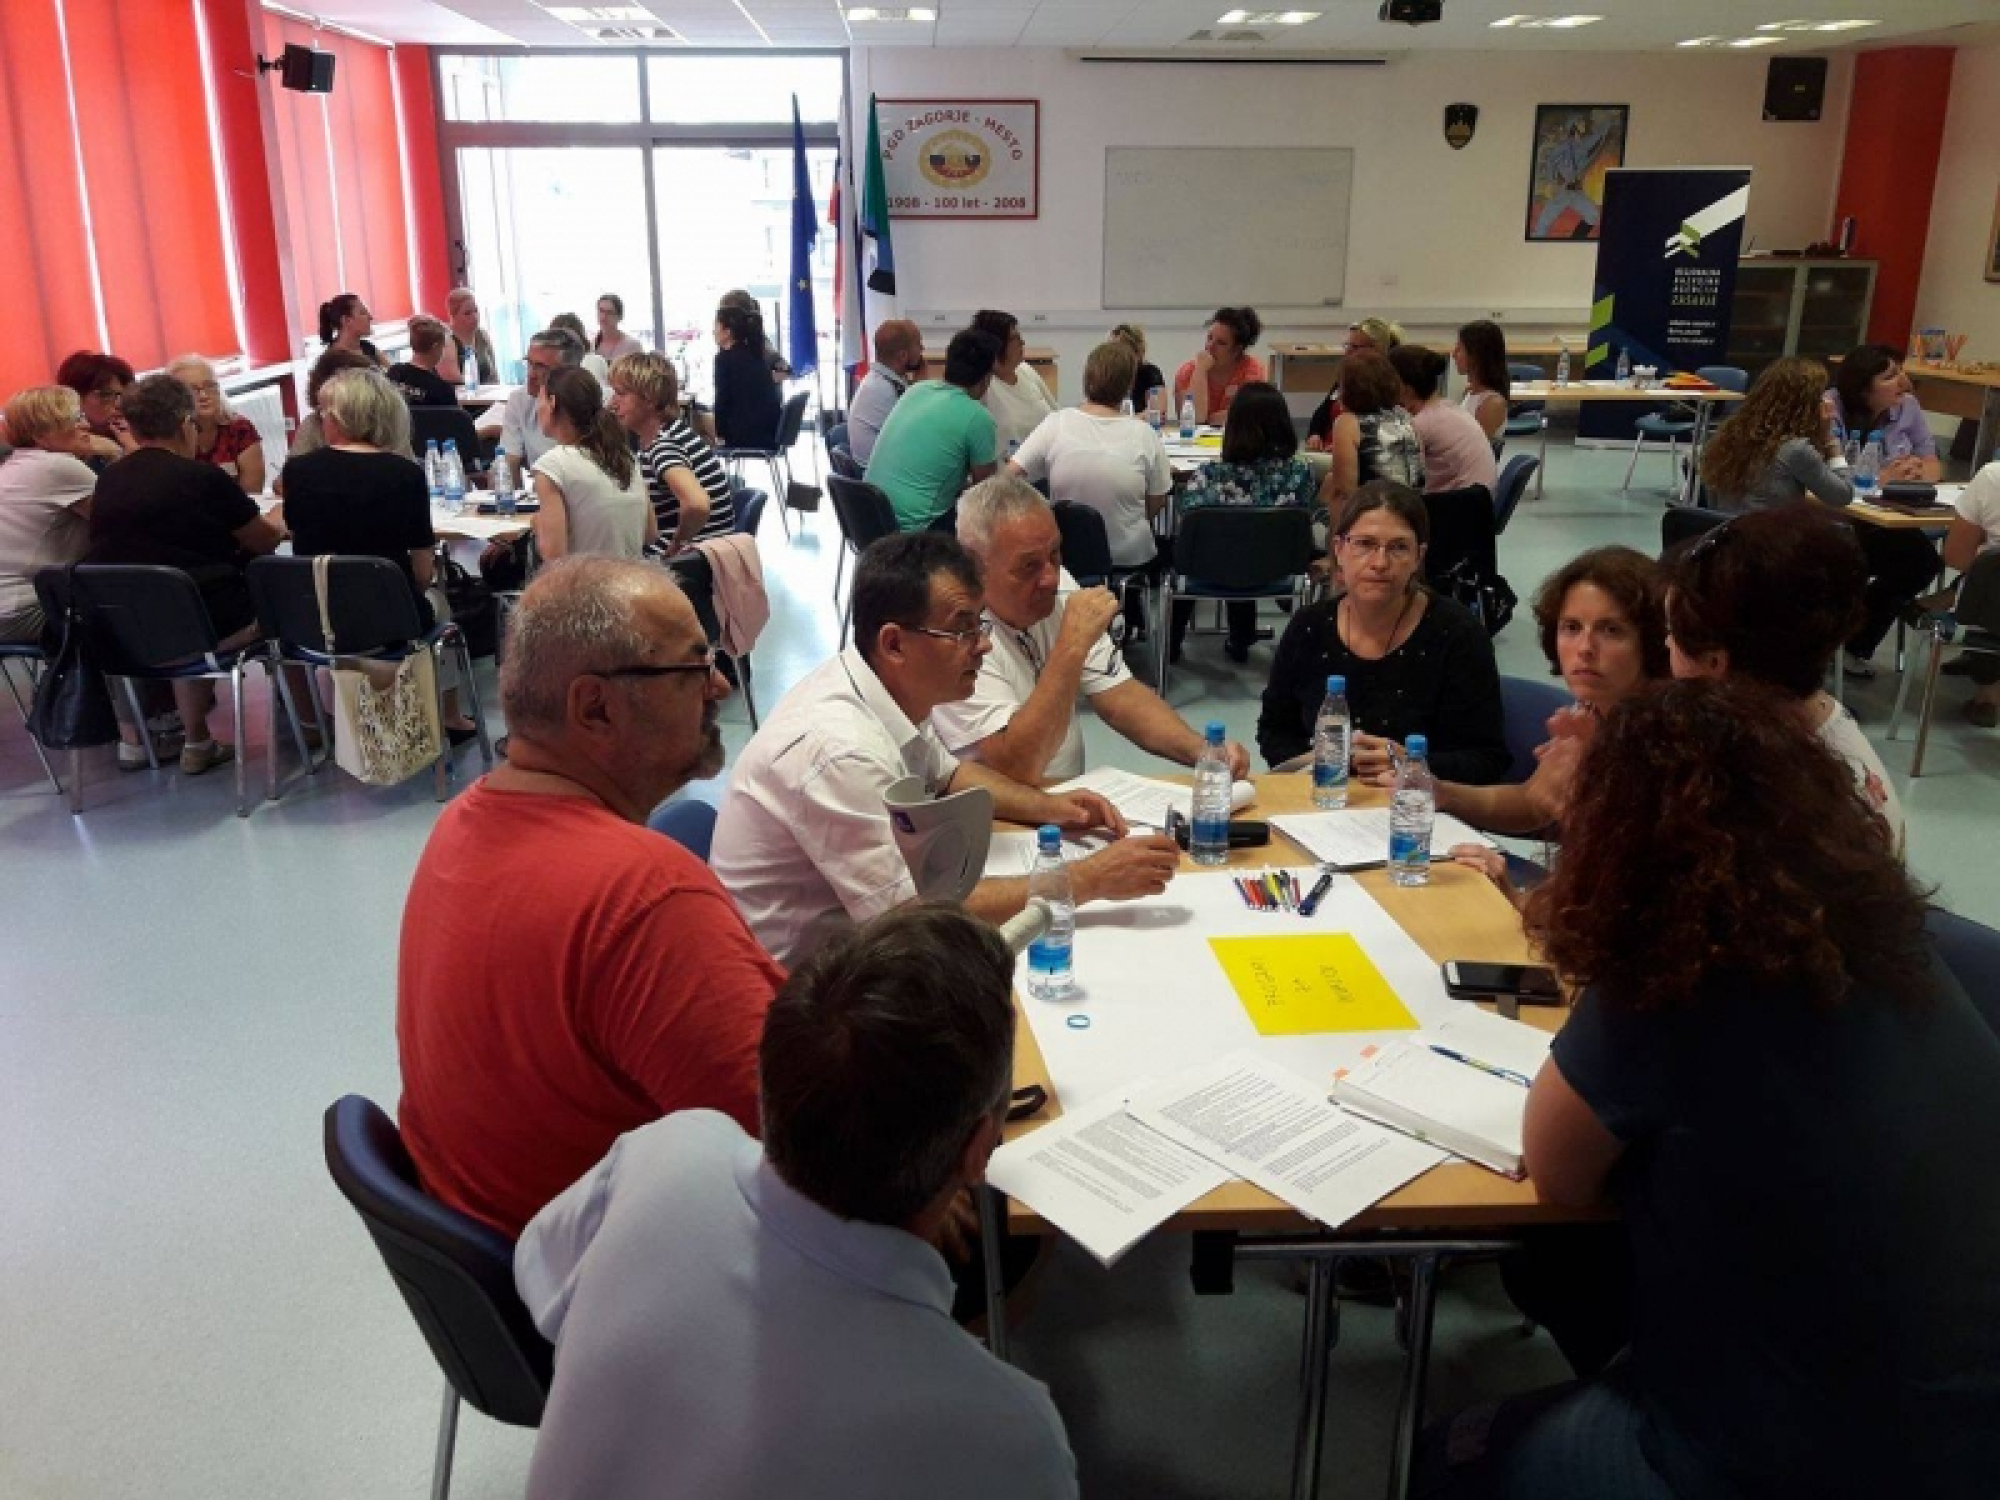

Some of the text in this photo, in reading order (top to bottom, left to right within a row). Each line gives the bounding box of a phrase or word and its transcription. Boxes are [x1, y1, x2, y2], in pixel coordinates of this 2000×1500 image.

[905, 110, 970, 131] ZAGORJE
[984, 116, 1023, 161] MESTO
[887, 197, 920, 208] 1908
[935, 197, 957, 208] 100
[962, 197, 980, 208] let
[994, 197, 1025, 208] 2008
